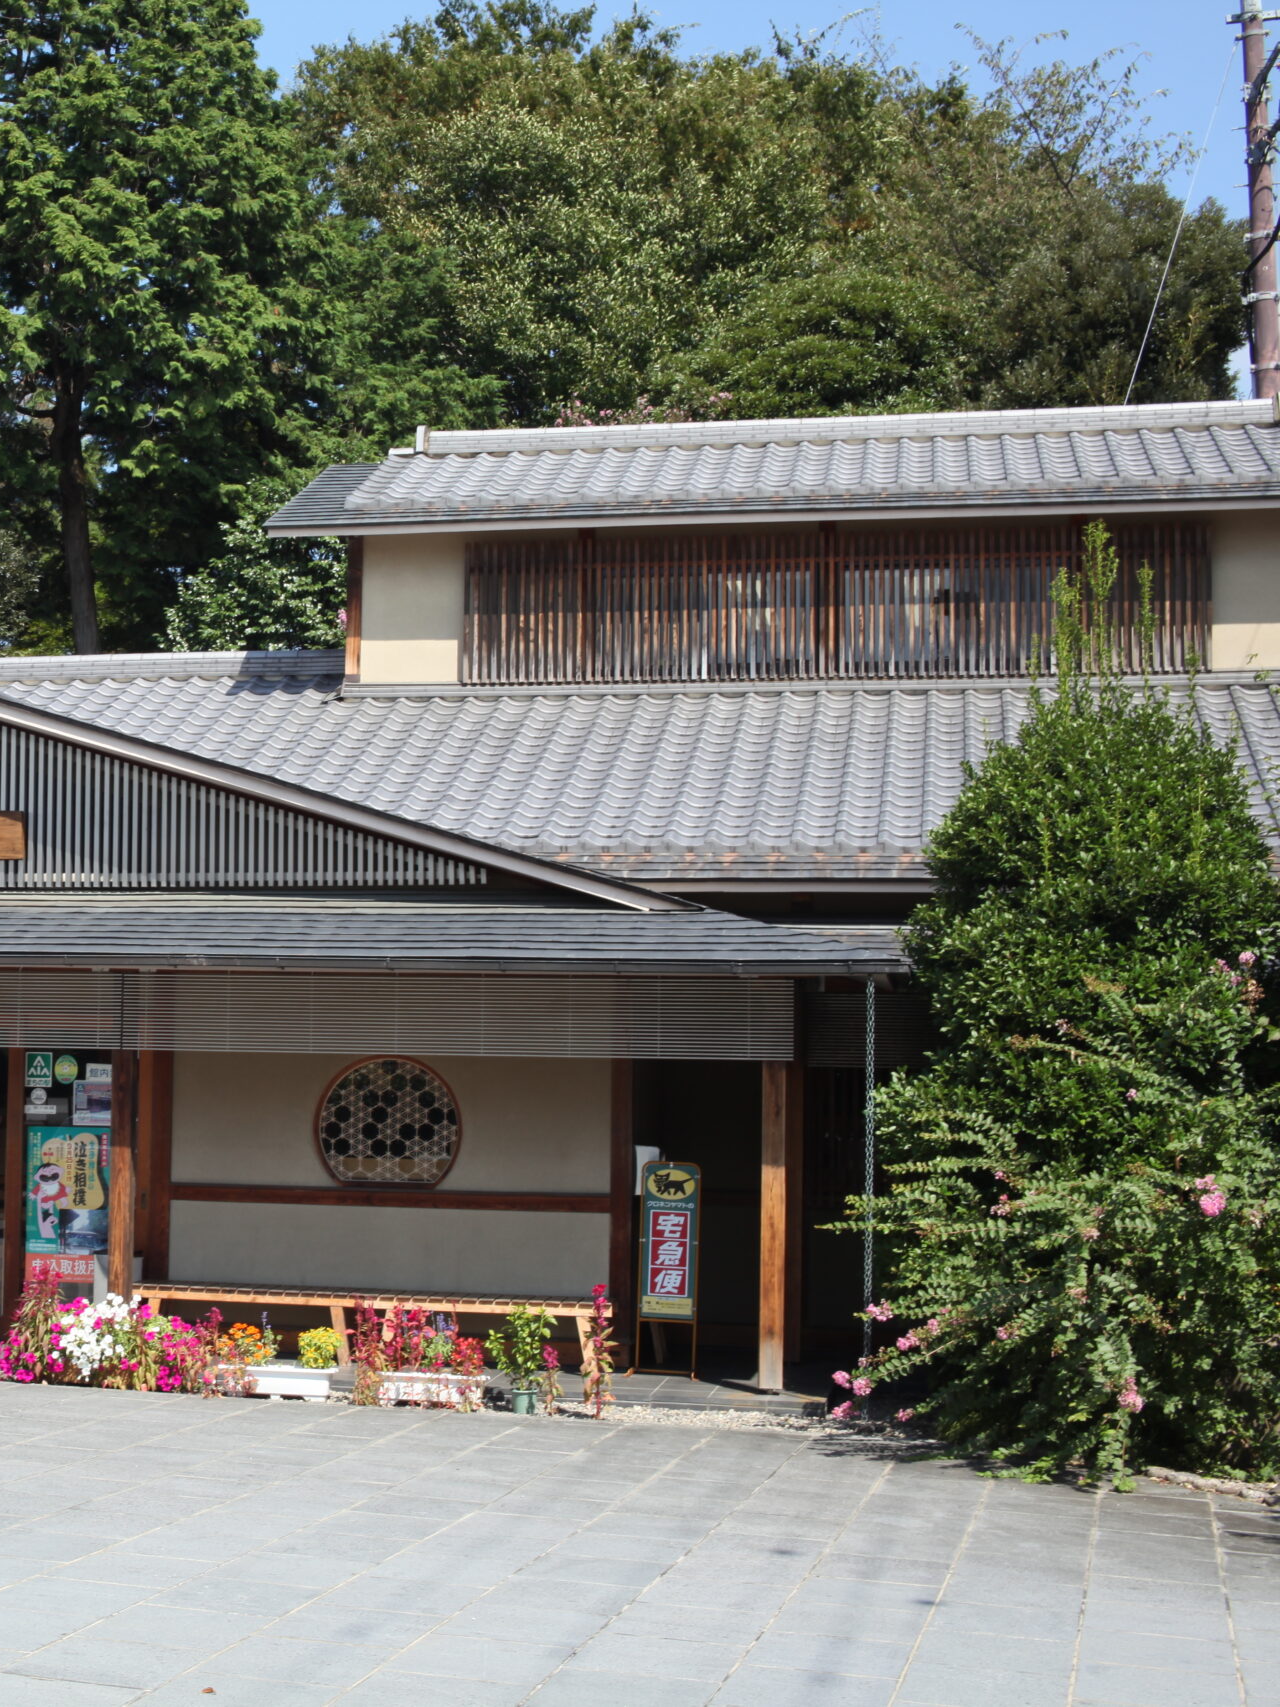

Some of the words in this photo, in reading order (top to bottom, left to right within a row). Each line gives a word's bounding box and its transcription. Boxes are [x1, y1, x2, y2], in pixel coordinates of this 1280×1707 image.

[89, 1068, 113, 1078] 館内
[73, 1140, 87, 1207] 泣き相撲
[647, 1200, 695, 1209] クロネコヤマトの
[653, 1213, 686, 1294] 宅急便
